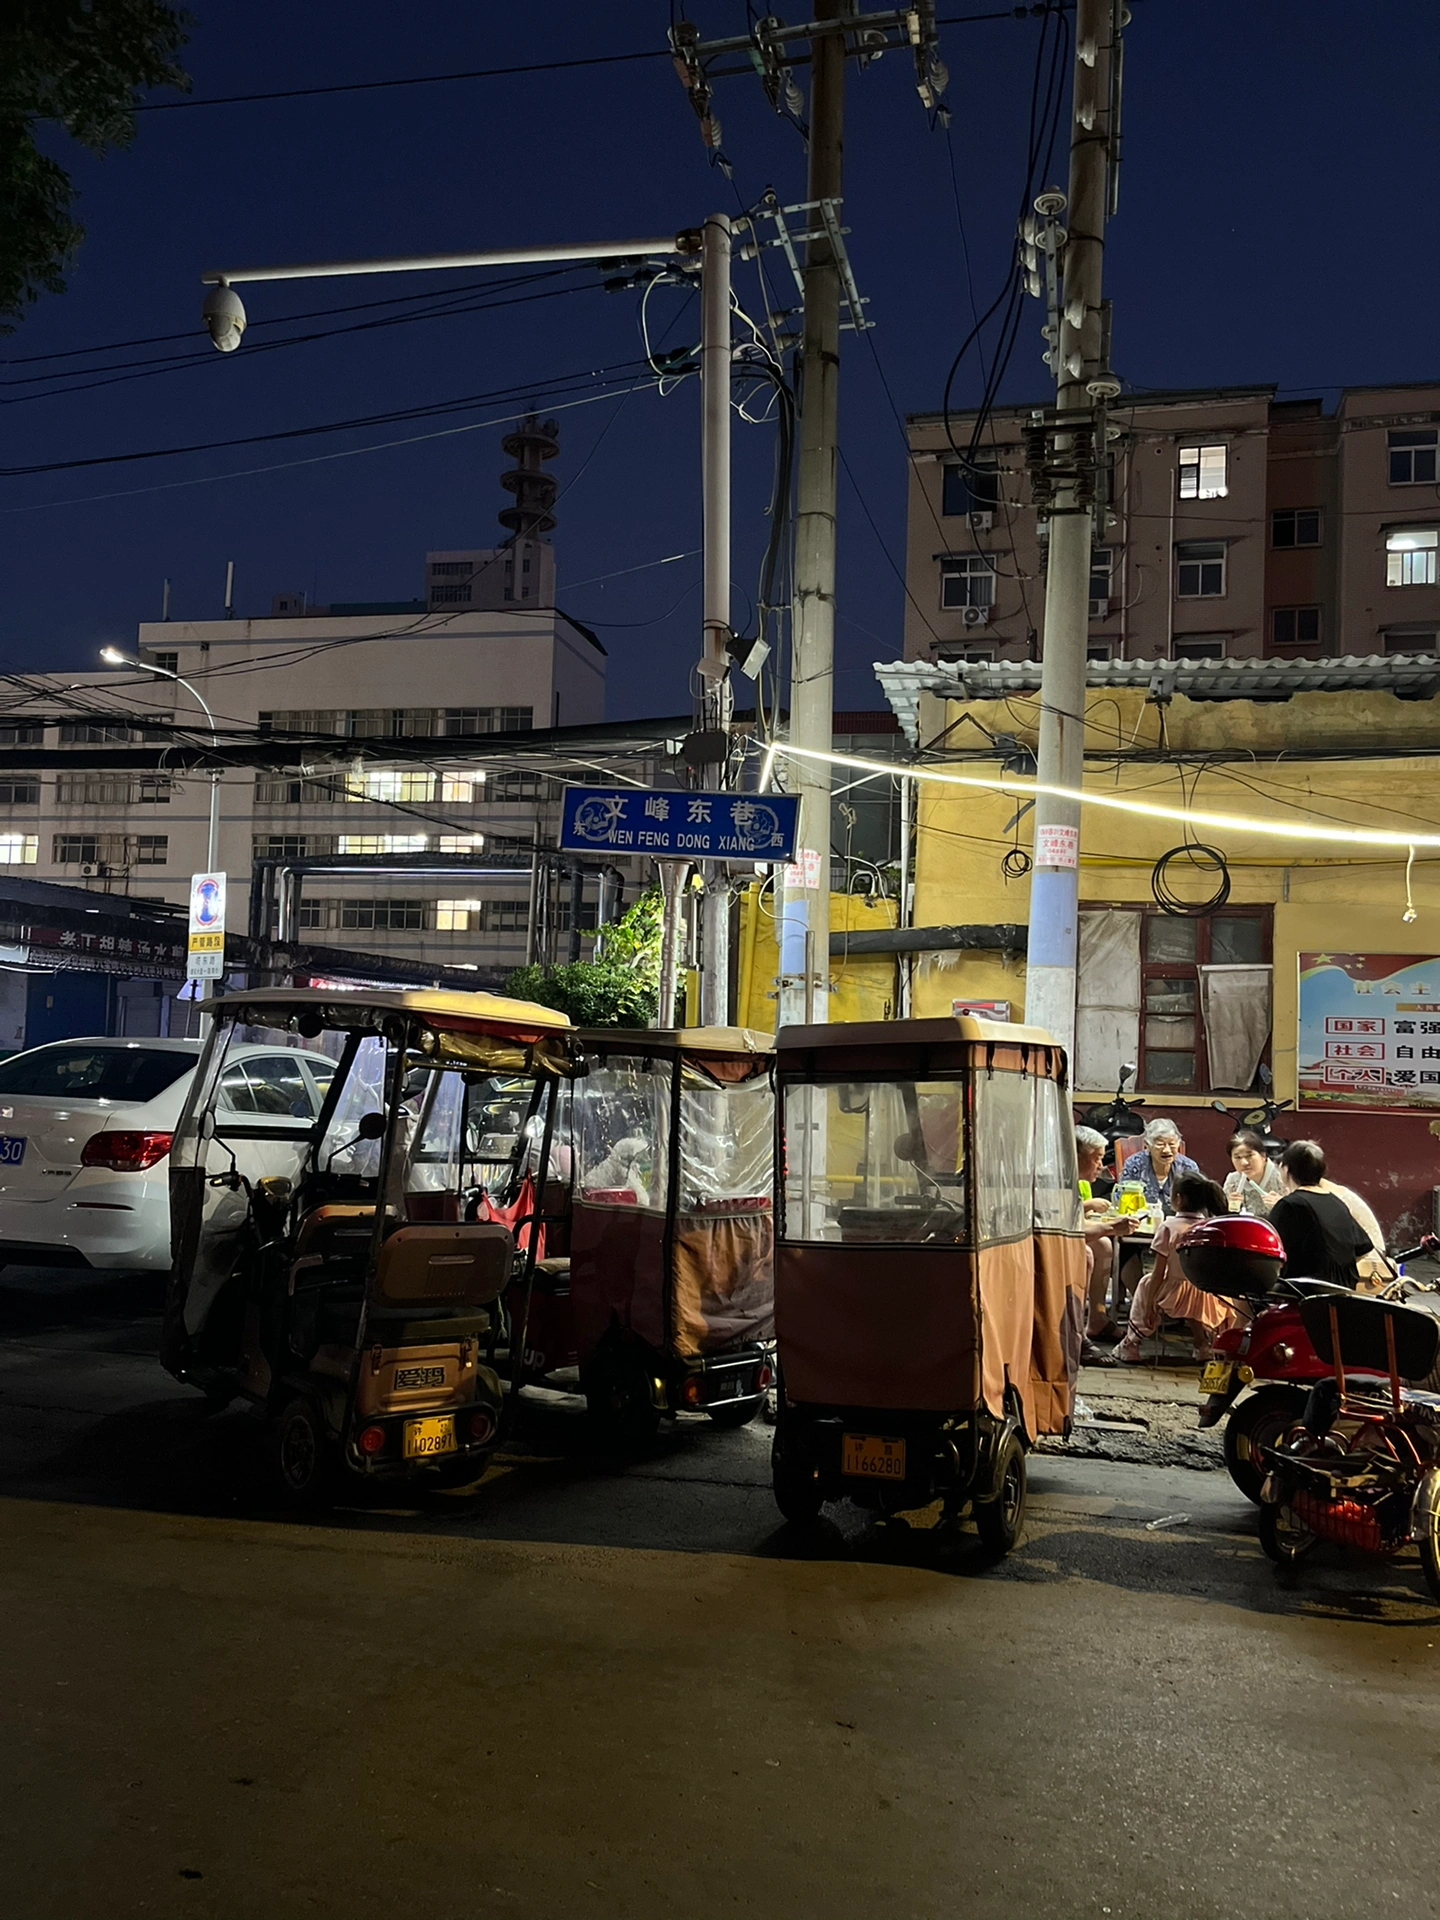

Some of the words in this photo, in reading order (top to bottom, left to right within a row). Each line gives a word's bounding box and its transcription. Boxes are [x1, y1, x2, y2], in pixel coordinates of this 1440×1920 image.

[605, 795, 756, 826] 文峰东巷
[573, 822, 587, 836] 东
[608, 830, 633, 845] WEN
[637, 831, 670, 847] FENG
[677, 834, 710, 850] DONG
[718, 835, 755, 851] XIANG
[770, 832, 785, 848] 西
[1334, 1020, 1377, 1032] 国家
[1394, 1020, 1440, 1035] 富强
[1334, 1045, 1376, 1057] 社会
[1396, 1045, 1440, 1059] 自由
[1335, 1069, 1377, 1081] 个人
[1394, 1070, 1440, 1085] 爱国
[408, 1433, 452, 1454] 1102897
[847, 1454, 901, 1474] 1166280
